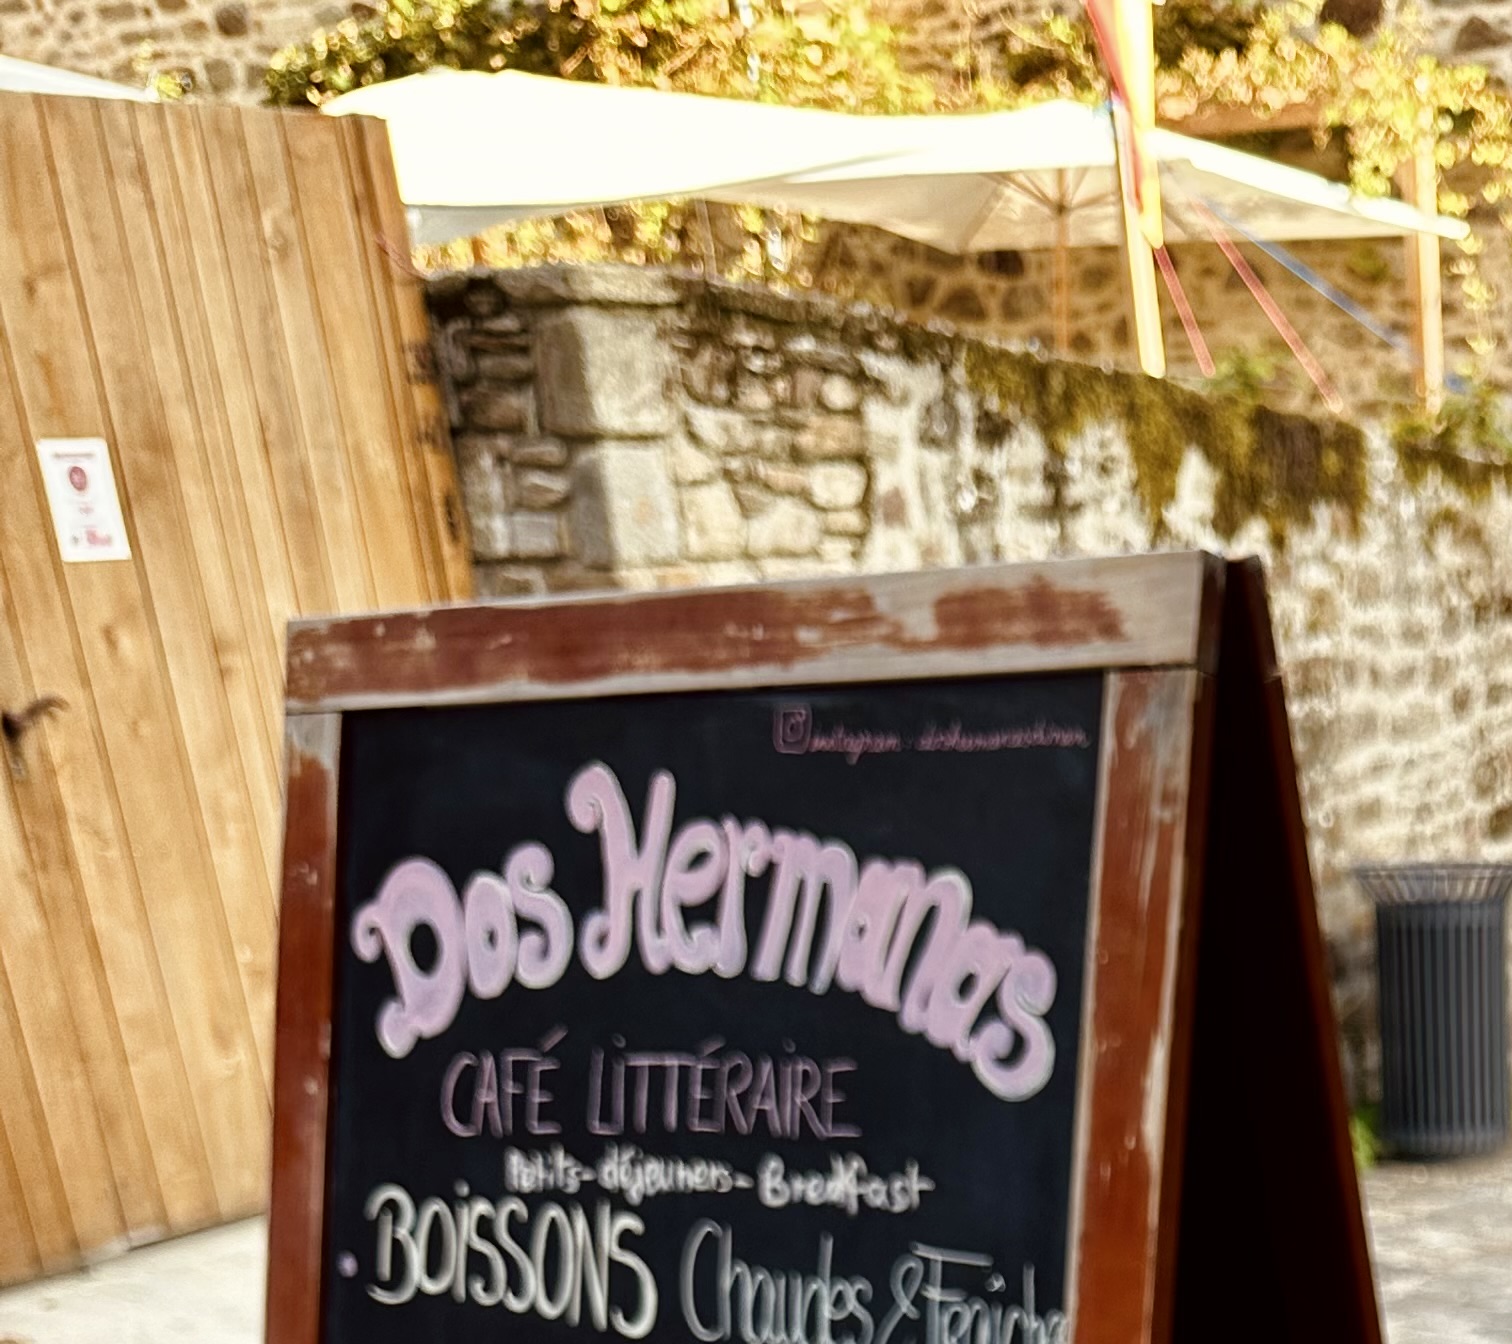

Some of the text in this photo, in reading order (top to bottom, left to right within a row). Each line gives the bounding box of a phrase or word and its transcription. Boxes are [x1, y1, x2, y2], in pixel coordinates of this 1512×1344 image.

[352, 760, 1057, 1101] Dos Hermanas
[441, 1024, 568, 1138] CAFÉ
[756, 1151, 936, 1216] Breakfast
[364, 1178, 658, 1339] BOISSONS
